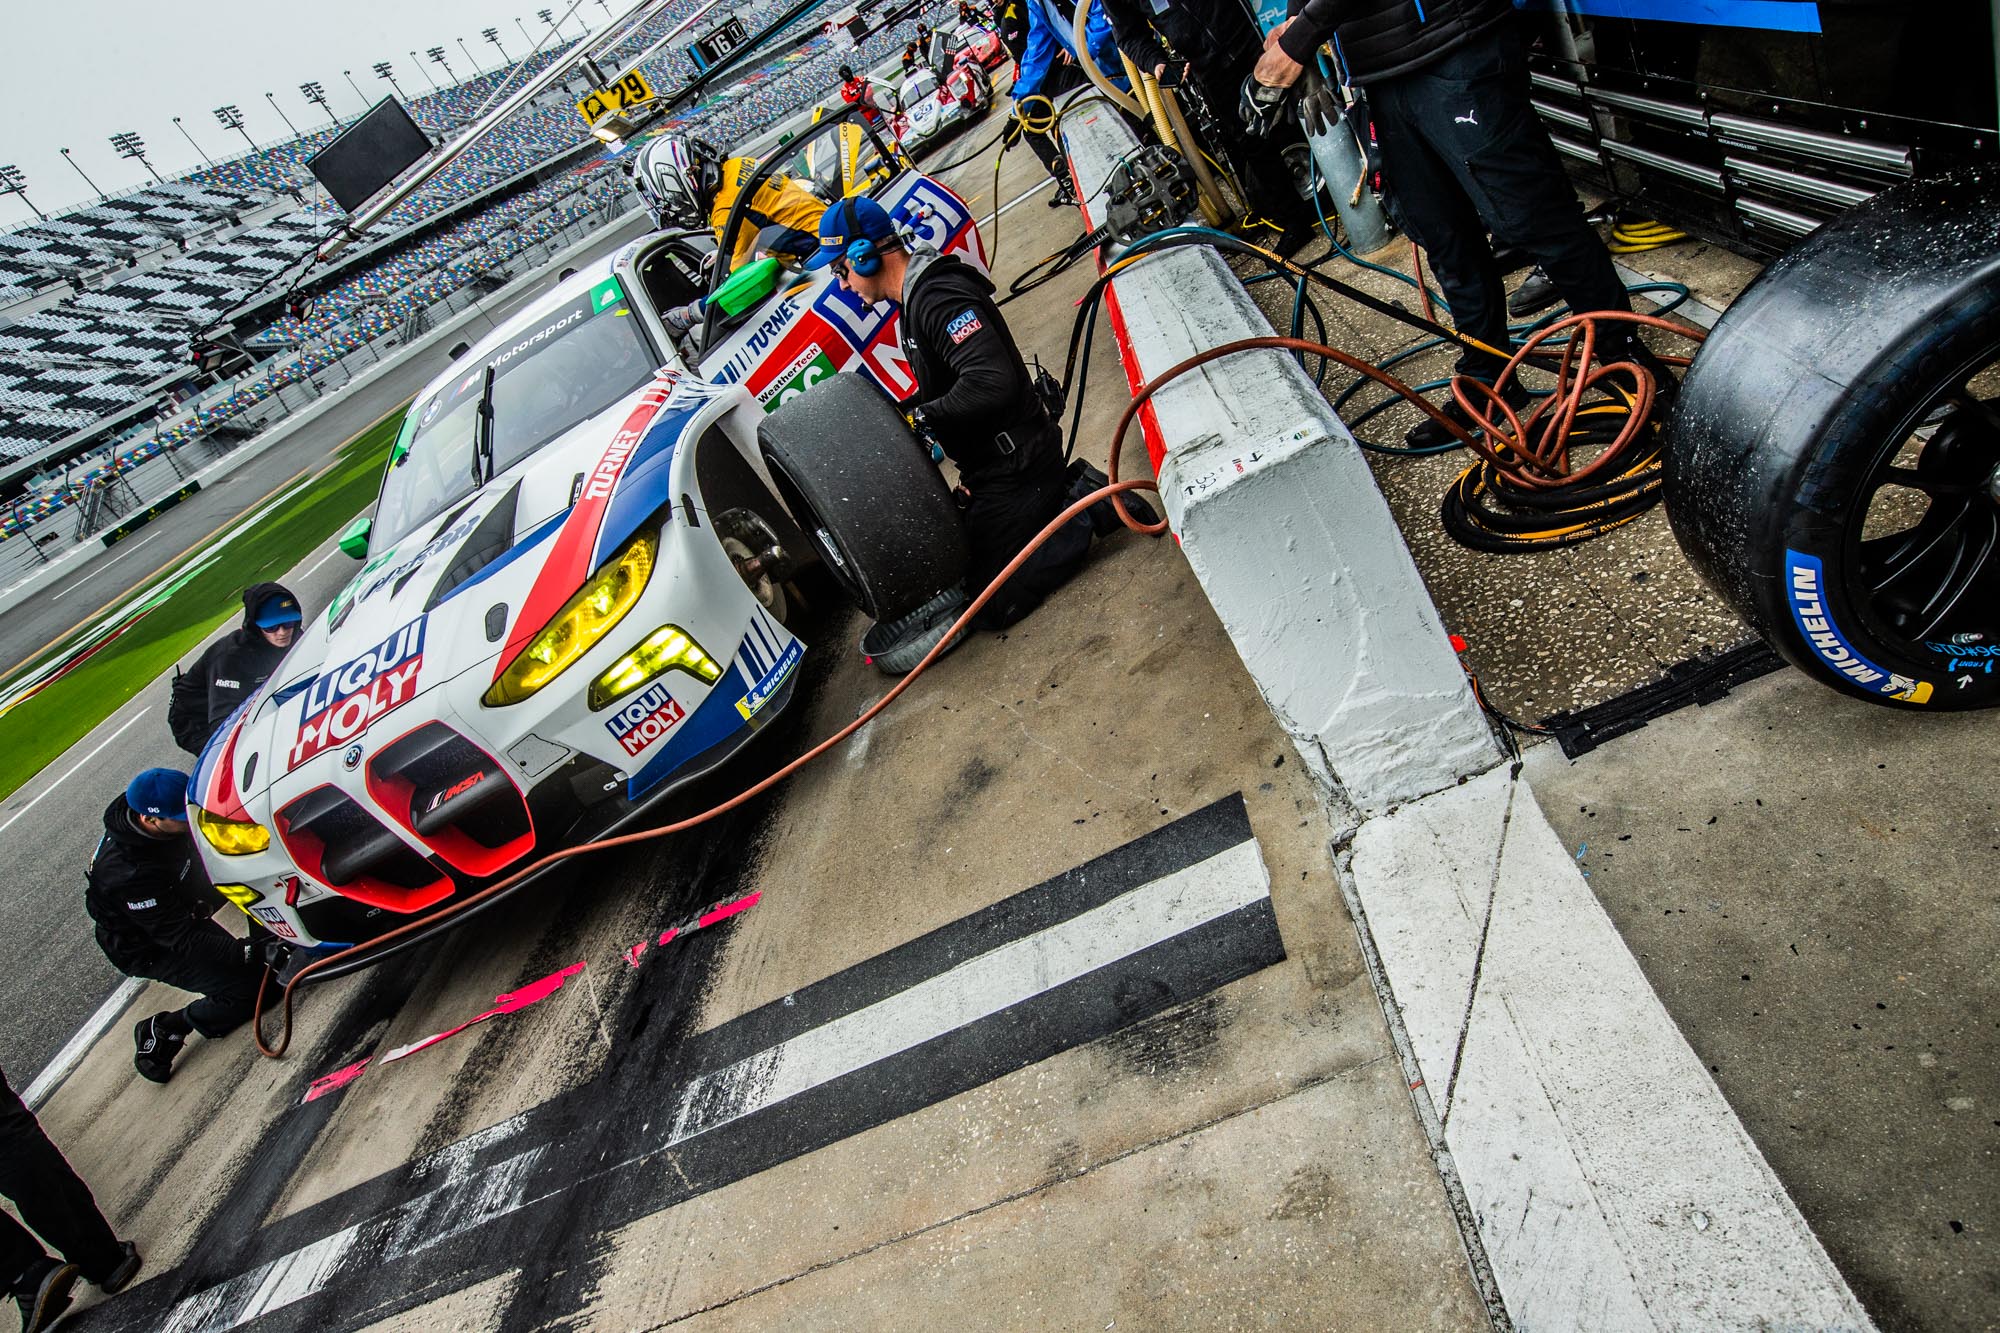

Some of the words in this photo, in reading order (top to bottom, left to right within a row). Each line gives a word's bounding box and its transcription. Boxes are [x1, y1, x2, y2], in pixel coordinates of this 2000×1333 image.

[1259, 8, 1287, 26] FPL
[709, 34, 732, 58] 16
[611, 73, 646, 108] 29
[488, 308, 583, 370] Motorsport
[746, 297, 801, 356] TURNER
[947, 310, 976, 335] LIQUI
[953, 320, 980, 343] MOLY
[758, 343, 820, 404] WeatherTech
[585, 429, 641, 500] TURNER
[1793, 566, 1884, 684] MICHELIN
[305, 617, 422, 721] LIQUI
[762, 646, 797, 695] MICHELIN
[293, 659, 421, 765] MOLY
[608, 685, 669, 738] LIQUI
[622, 700, 680, 754] MOLY
